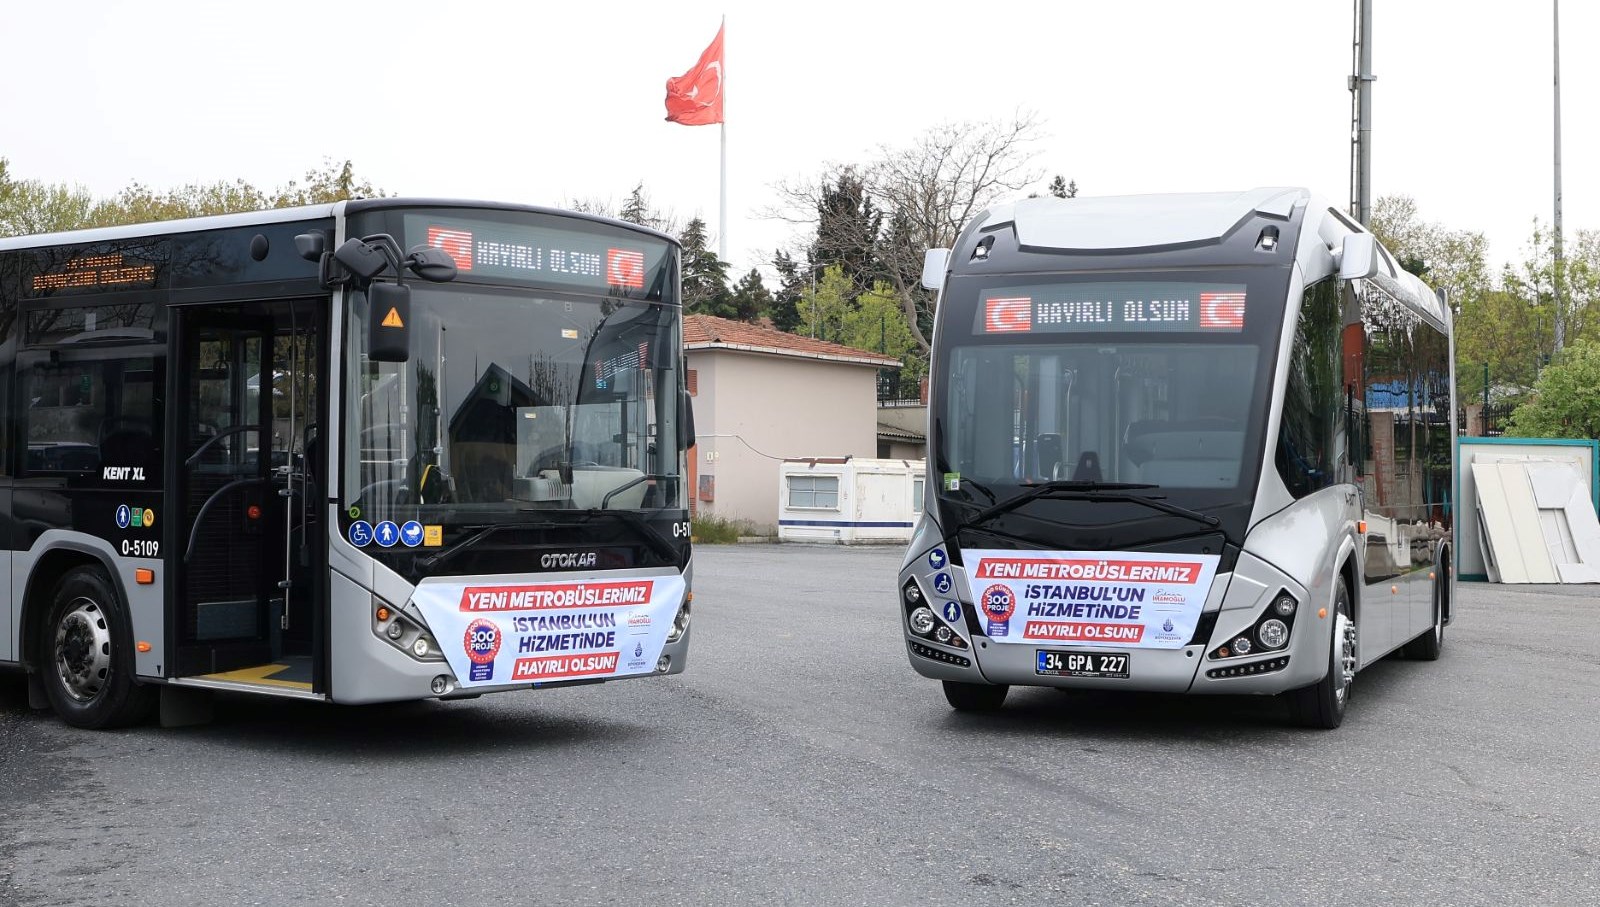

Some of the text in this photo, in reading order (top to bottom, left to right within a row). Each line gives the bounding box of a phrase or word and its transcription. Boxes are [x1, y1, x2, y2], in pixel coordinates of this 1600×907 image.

[477, 241, 600, 276] HAYIRLI OLSUN
[1037, 300, 1189, 323] HAYIRLI OLSUN
[103, 466, 146, 481] KENT XL
[540, 552, 597, 568] OTOKAR
[983, 562, 1192, 582] YENİ METROBÜSLERİMİZ
[468, 585, 646, 609] YENİ METROBÜSLERİMİZ
[987, 595, 1010, 605] 300
[1024, 584, 1146, 602] İSTANBUL'UN
[1027, 602, 1142, 620] HİZMETİNDE
[512, 612, 616, 633] İSTANBUL'UN
[1028, 622, 1139, 639] HAYIRLI OLSUN!
[470, 631, 496, 643] 300
[518, 631, 616, 654] HİZMETİNDE
[470, 642, 496, 651] PROJE
[516, 658, 570, 676] HAYIRLI
[571, 656, 616, 674] OLSUN!
[1046, 653, 1126, 672] 34 GPA 227
